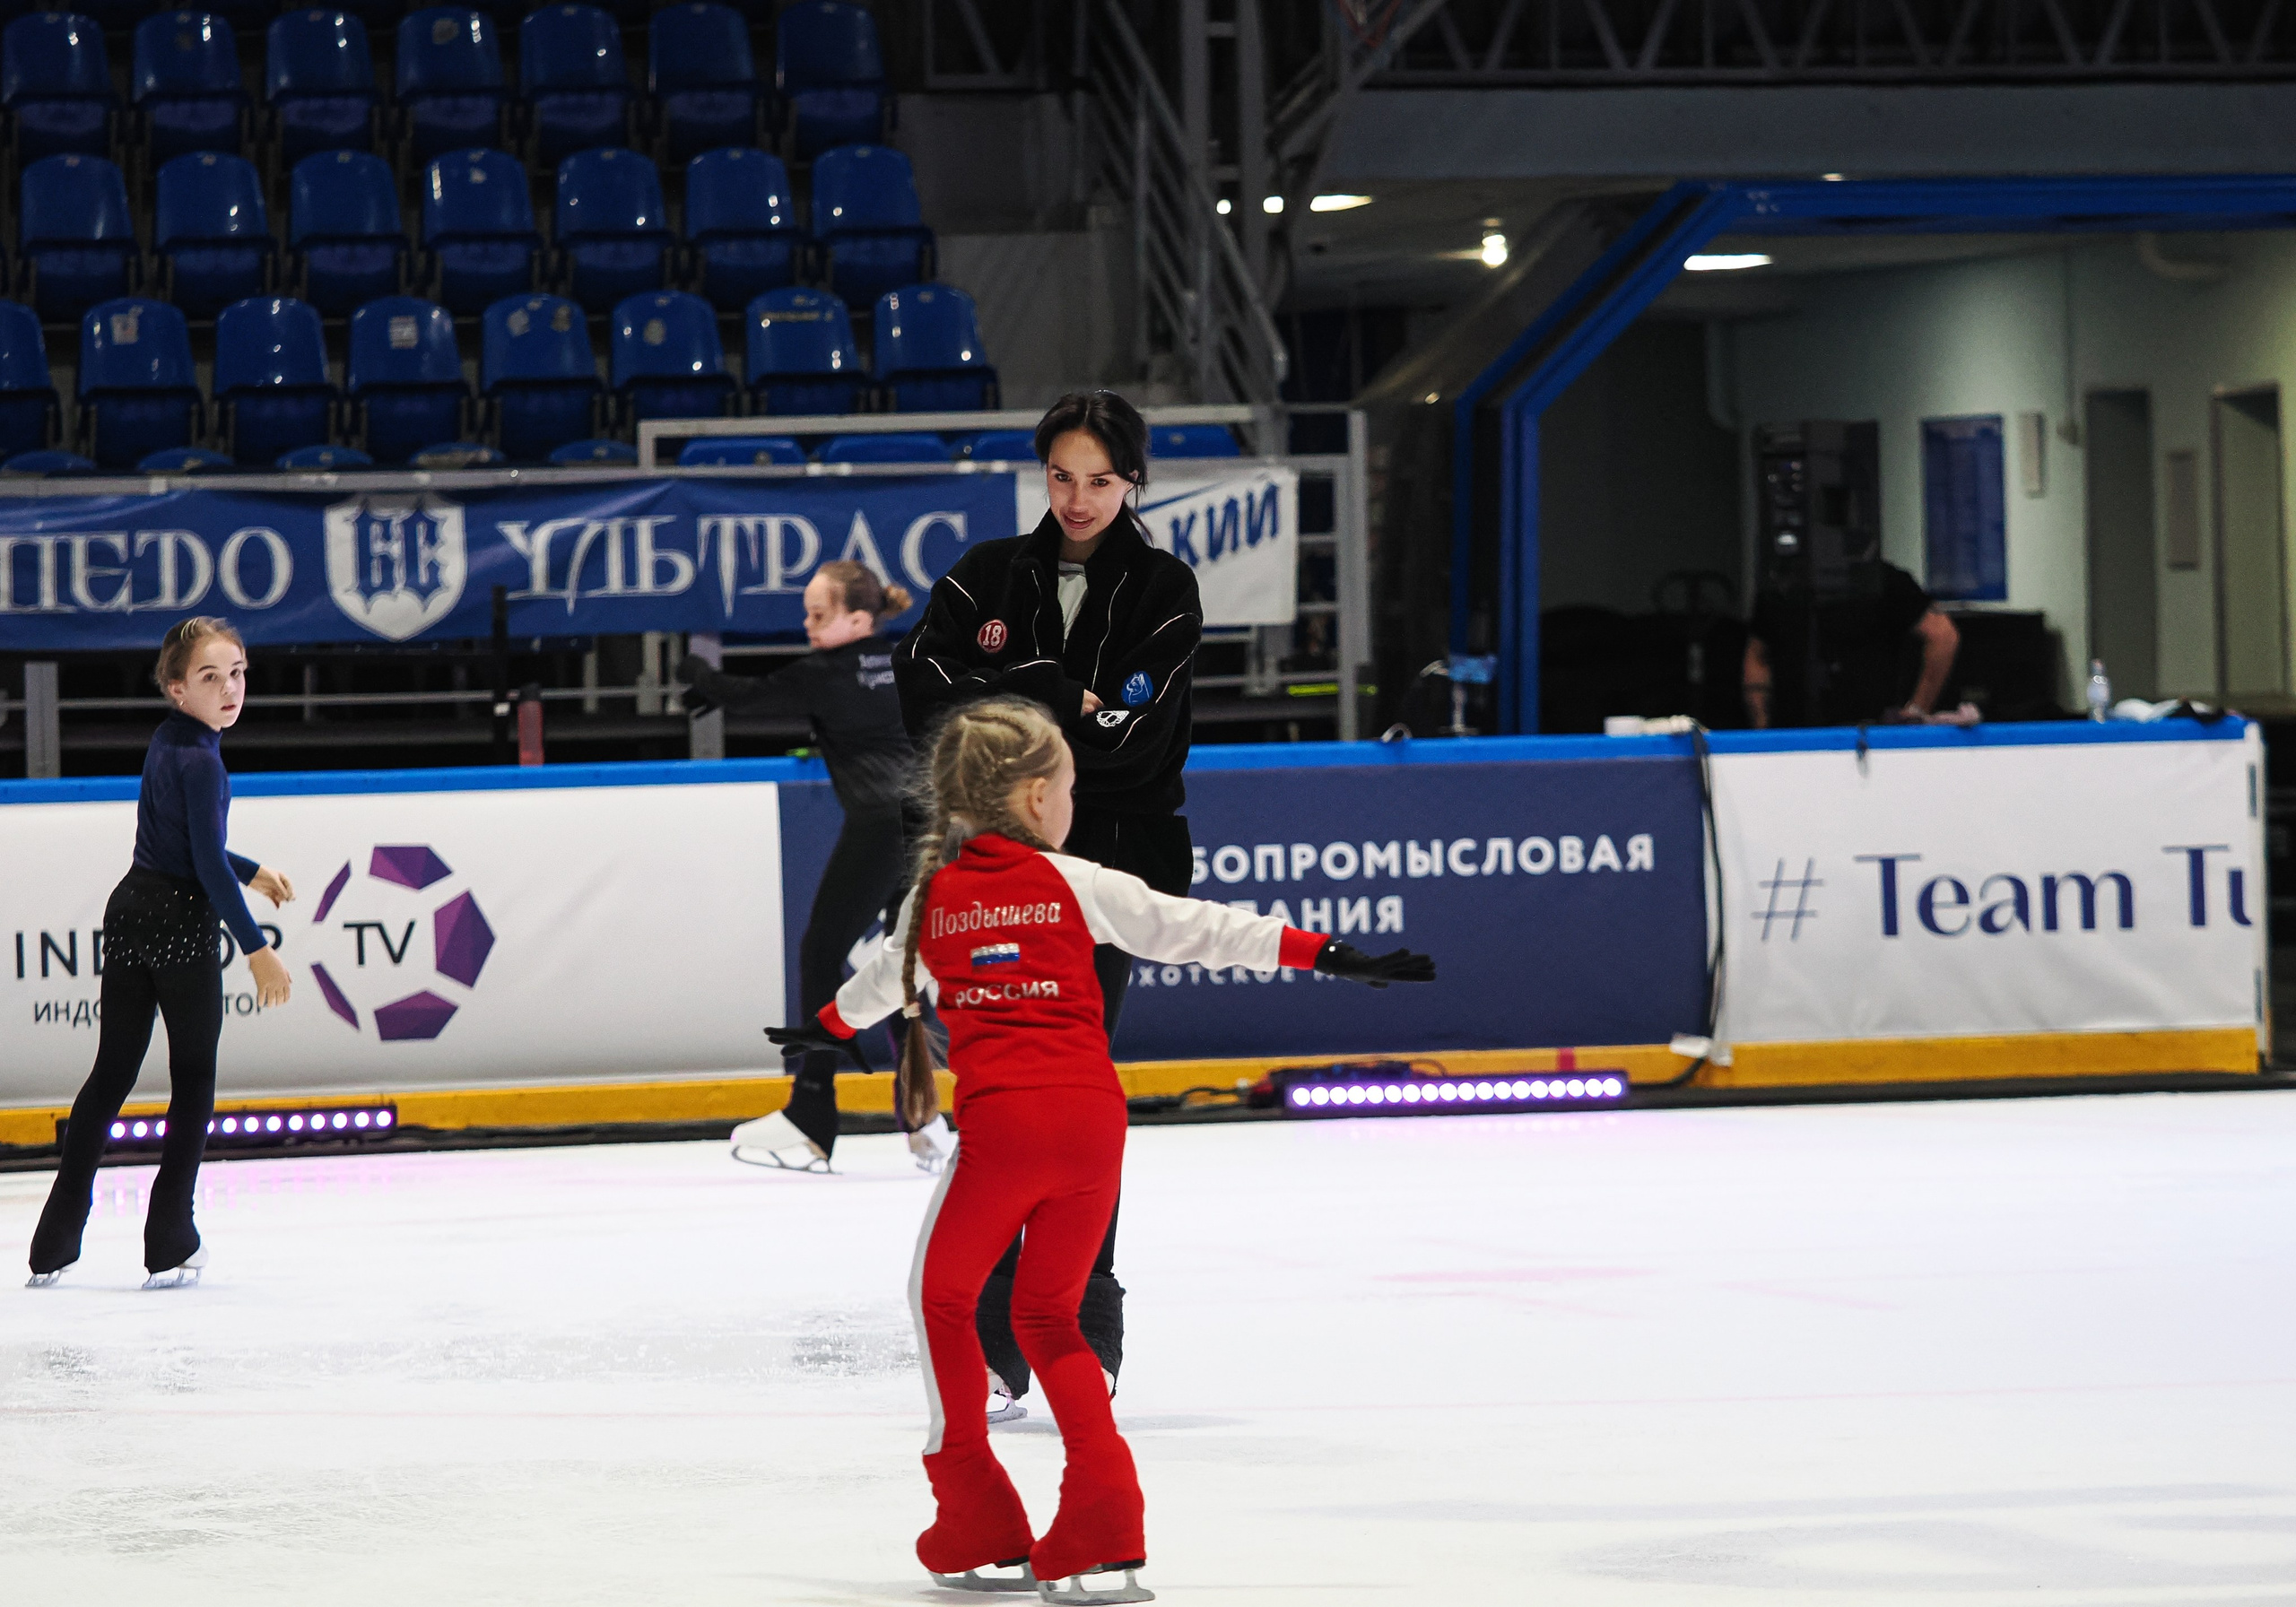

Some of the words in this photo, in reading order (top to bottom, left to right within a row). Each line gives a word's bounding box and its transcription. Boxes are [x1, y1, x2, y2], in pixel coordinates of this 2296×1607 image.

[982, 624, 1003, 647] 18
[1853, 853, 2134, 938] Team
[931, 900, 1061, 939] Поздышева
[342, 919, 417, 967] TV
[955, 980, 1059, 1009] РОССИЯ
